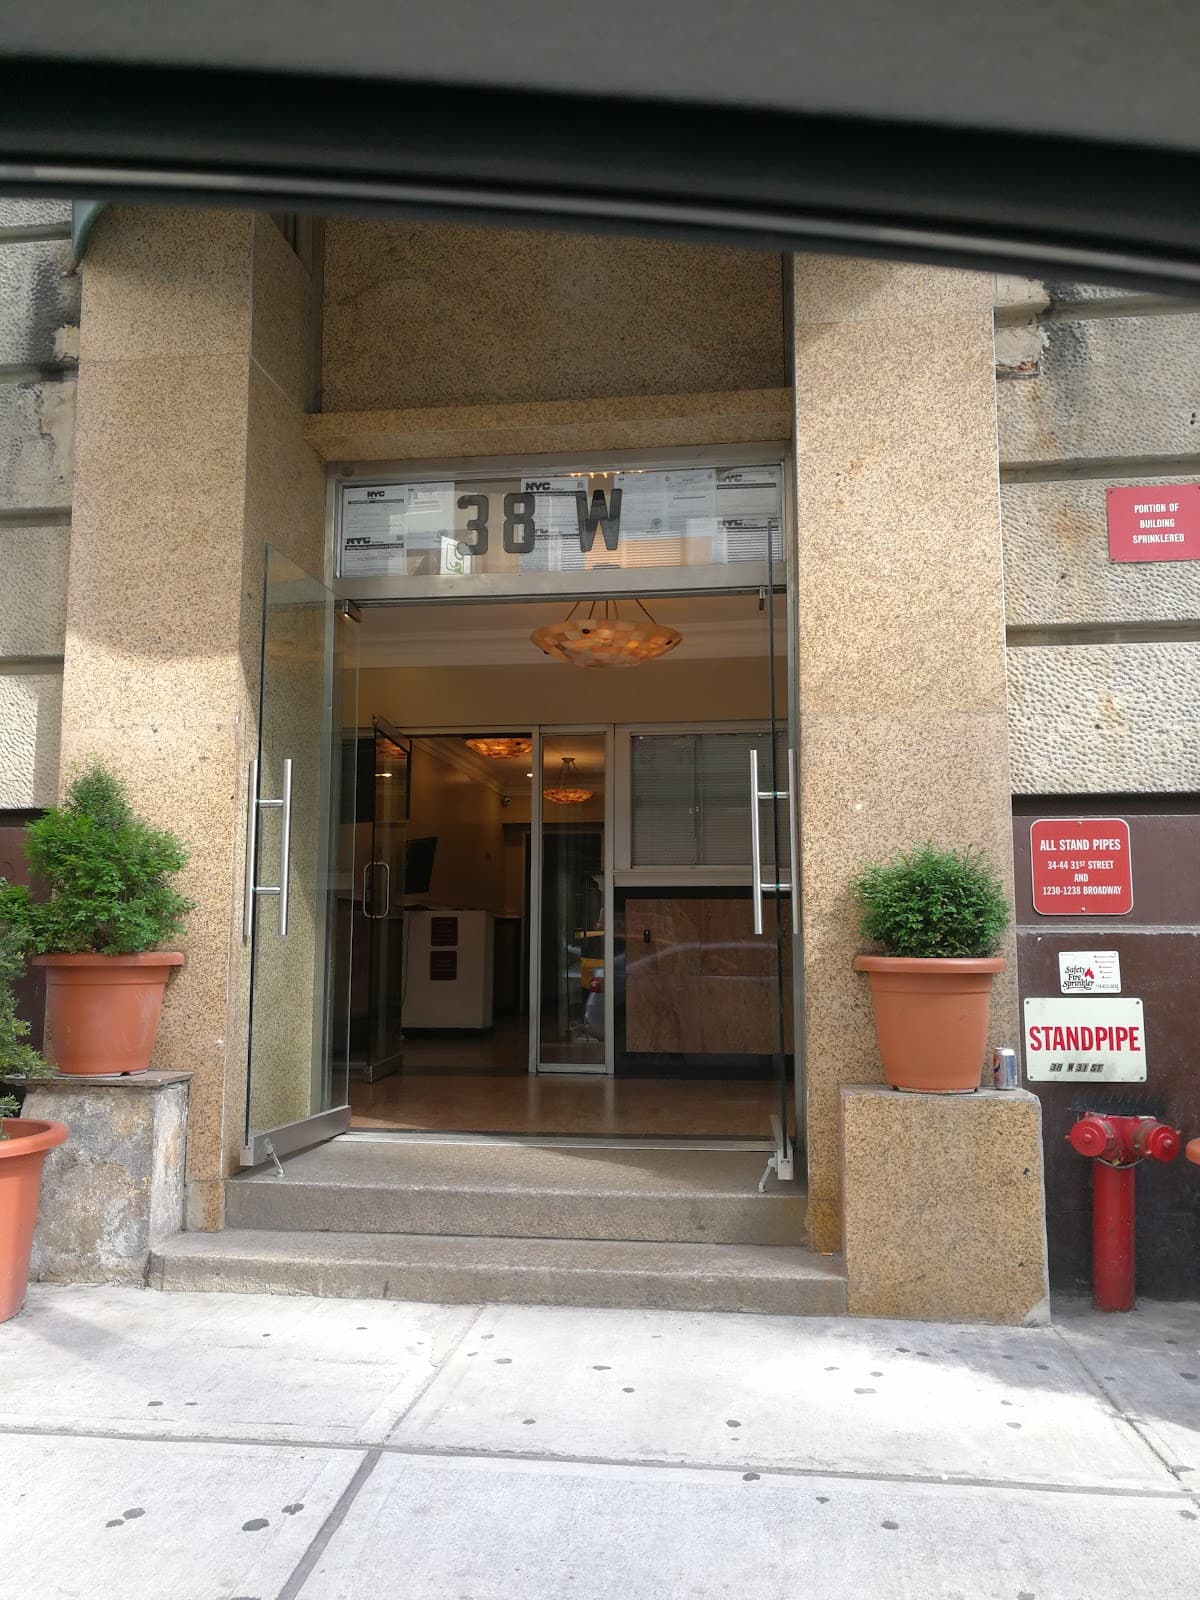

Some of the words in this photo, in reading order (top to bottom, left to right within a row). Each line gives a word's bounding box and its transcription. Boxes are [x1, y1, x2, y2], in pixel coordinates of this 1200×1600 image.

[525, 482, 551, 491] NYC
[367, 490, 385, 498] NYC
[1134, 504, 1166, 513] PORTION
[1169, 503, 1179, 512] OF
[457, 493, 535, 555] 38
[576, 489, 622, 552] W
[1139, 519, 1175, 528] BUILDING
[346, 536, 371, 545] NYC
[1133, 534, 1184, 544] SPRINKLERED
[1039, 839, 1056, 851] ALL
[1059, 839, 1089, 851] STAND
[1093, 838, 1121, 851] PIPES
[1047, 860, 1069, 870] 34-44
[1070, 860, 1086, 870] 31ST
[1088, 860, 1114, 870] STREET
[1074, 873, 1089, 883] AND
[1083, 885, 1122, 895] BROADWAY
[1065, 965, 1085, 975] Safety
[1062, 979, 1095, 990] Sprinkler
[1029, 1026, 1140, 1051] STANDPIPE
[1049, 1063, 1063, 1073] 38
[1066, 1063, 1075, 1073] W
[1075, 1063, 1089, 1073] 31
[1090, 1063, 1104, 1073] ST
